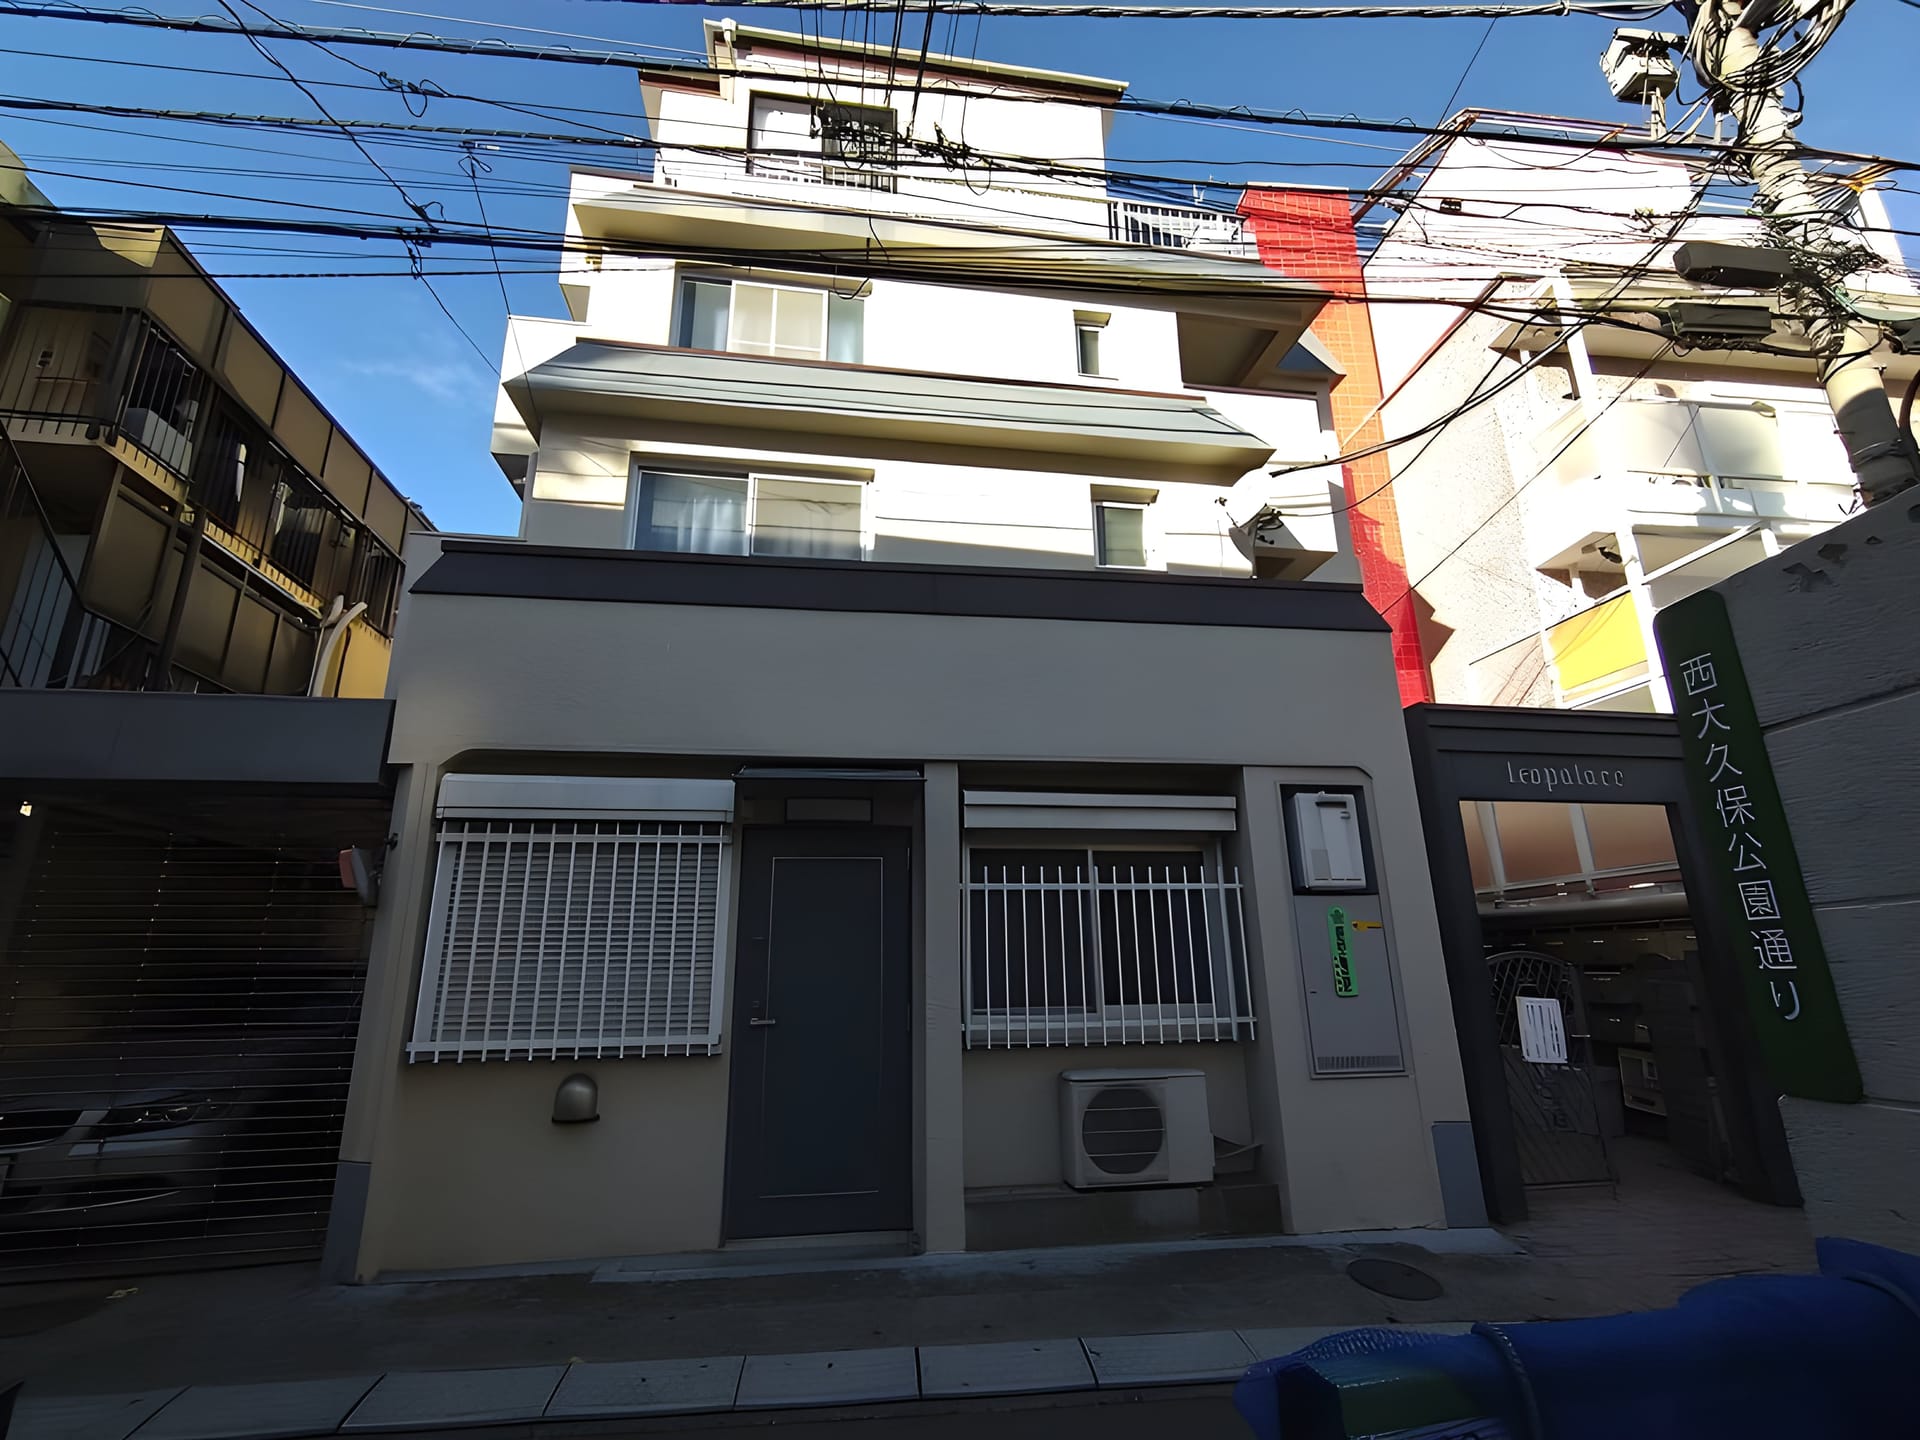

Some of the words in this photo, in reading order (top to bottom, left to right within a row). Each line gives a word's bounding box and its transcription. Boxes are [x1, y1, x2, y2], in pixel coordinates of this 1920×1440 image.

[1680, 653, 1800, 1020] 西大久保公園通り
